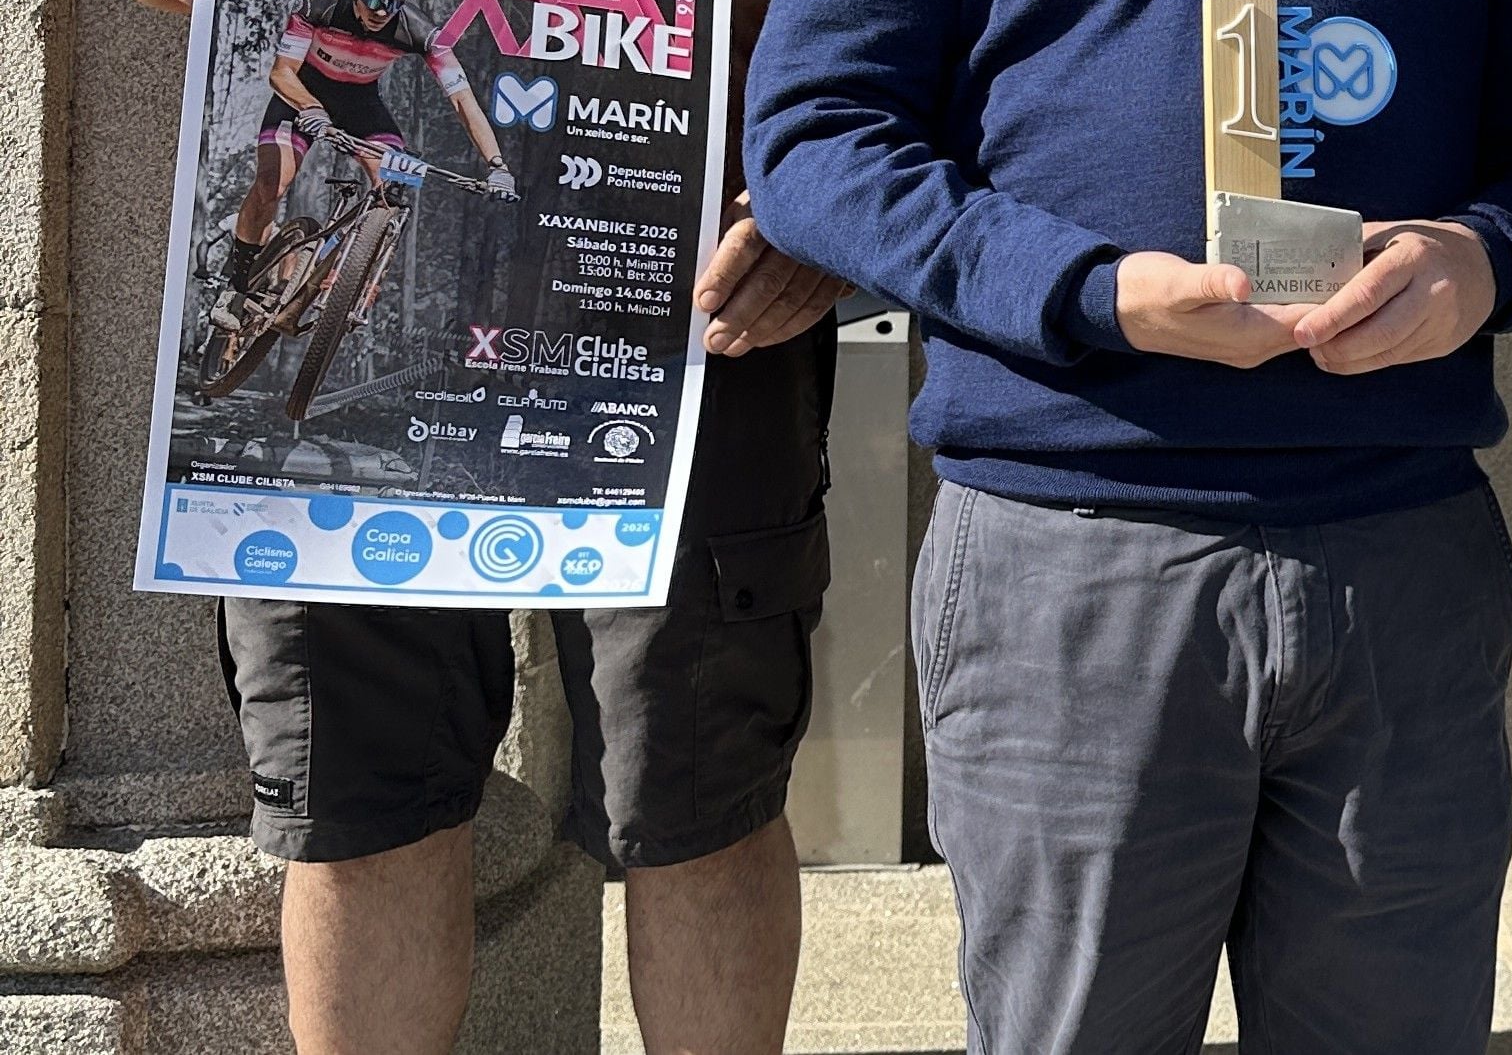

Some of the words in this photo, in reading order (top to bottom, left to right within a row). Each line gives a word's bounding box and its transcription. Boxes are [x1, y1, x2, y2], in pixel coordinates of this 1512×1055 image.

[531, 2, 692, 80] BIKE
[1277, 6, 1325, 178] MARÍN
[567, 96, 690, 135] MARÍN
[566, 126, 583, 136] Un
[584, 127, 612, 141] xeito
[615, 130, 630, 142] de
[631, 133, 650, 144] ser.
[608, 164, 682, 183] Deputación
[607, 176, 681, 194] Pontevedra
[538, 213, 635, 236] XAXANBIKE
[639, 225, 678, 240] 2026
[567, 236, 616, 252] Sábado
[620, 242, 675, 258] 13.06.26
[578, 254, 610, 266] 10:00
[626, 258, 674, 272] MiniBTT
[579, 265, 611, 277] 15:00
[627, 270, 645, 281] Btt
[648, 272, 673, 284] XCO
[552, 280, 612, 297] Domingo
[616, 287, 671, 302] 14.06.26
[1251, 280, 1323, 293] XANBIKE
[1326, 282, 1346, 292] 20
[579, 299, 612, 311] 11:00
[627, 303, 670, 317] MiniDH
[468, 325, 574, 367] XSM
[577, 336, 648, 361] Clube
[574, 357, 665, 382] Ciclista
[430, 422, 477, 441] dibay
[191, 471, 215, 482] XSM
[217, 474, 253, 485] CLUBE
[255, 476, 296, 488] CILISTA
[366, 528, 411, 545] Copa
[622, 523, 650, 533] 2026
[246, 545, 293, 558] Ciclismo
[362, 547, 419, 563] Galicia
[244, 557, 287, 572] Galego
